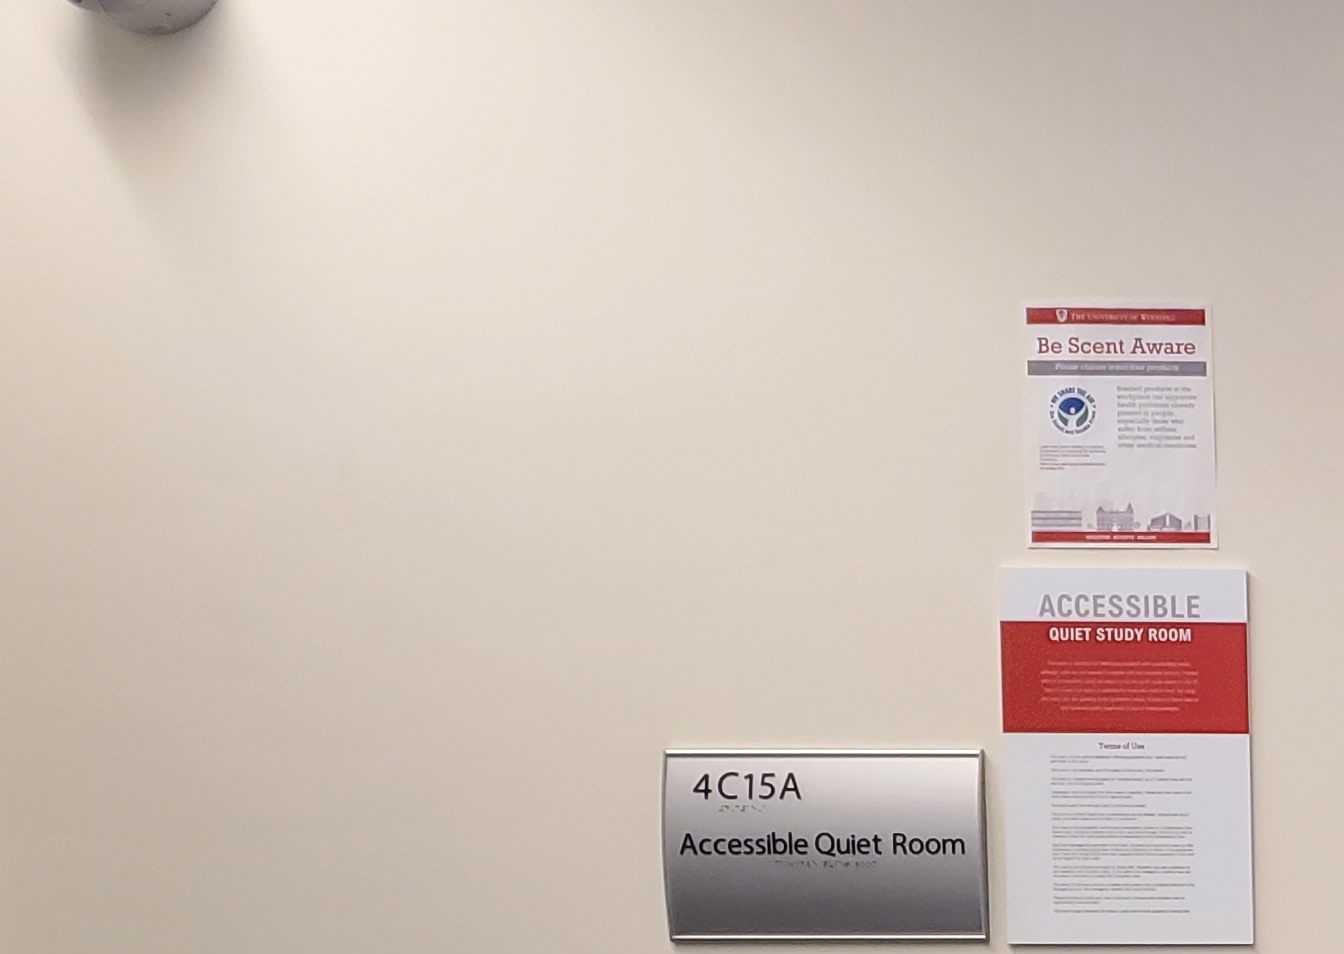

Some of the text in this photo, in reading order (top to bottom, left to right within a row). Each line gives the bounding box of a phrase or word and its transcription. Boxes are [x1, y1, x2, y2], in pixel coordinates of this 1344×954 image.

[1037, 337, 1196, 355] Be Scent Aware
[1039, 594, 1200, 618] ACCESSIBLE
[1049, 627, 1191, 642] QUIET STUDY ROOM
[692, 772, 802, 800] 4C15A
[680, 831, 966, 857] Accessible Quiet Room
